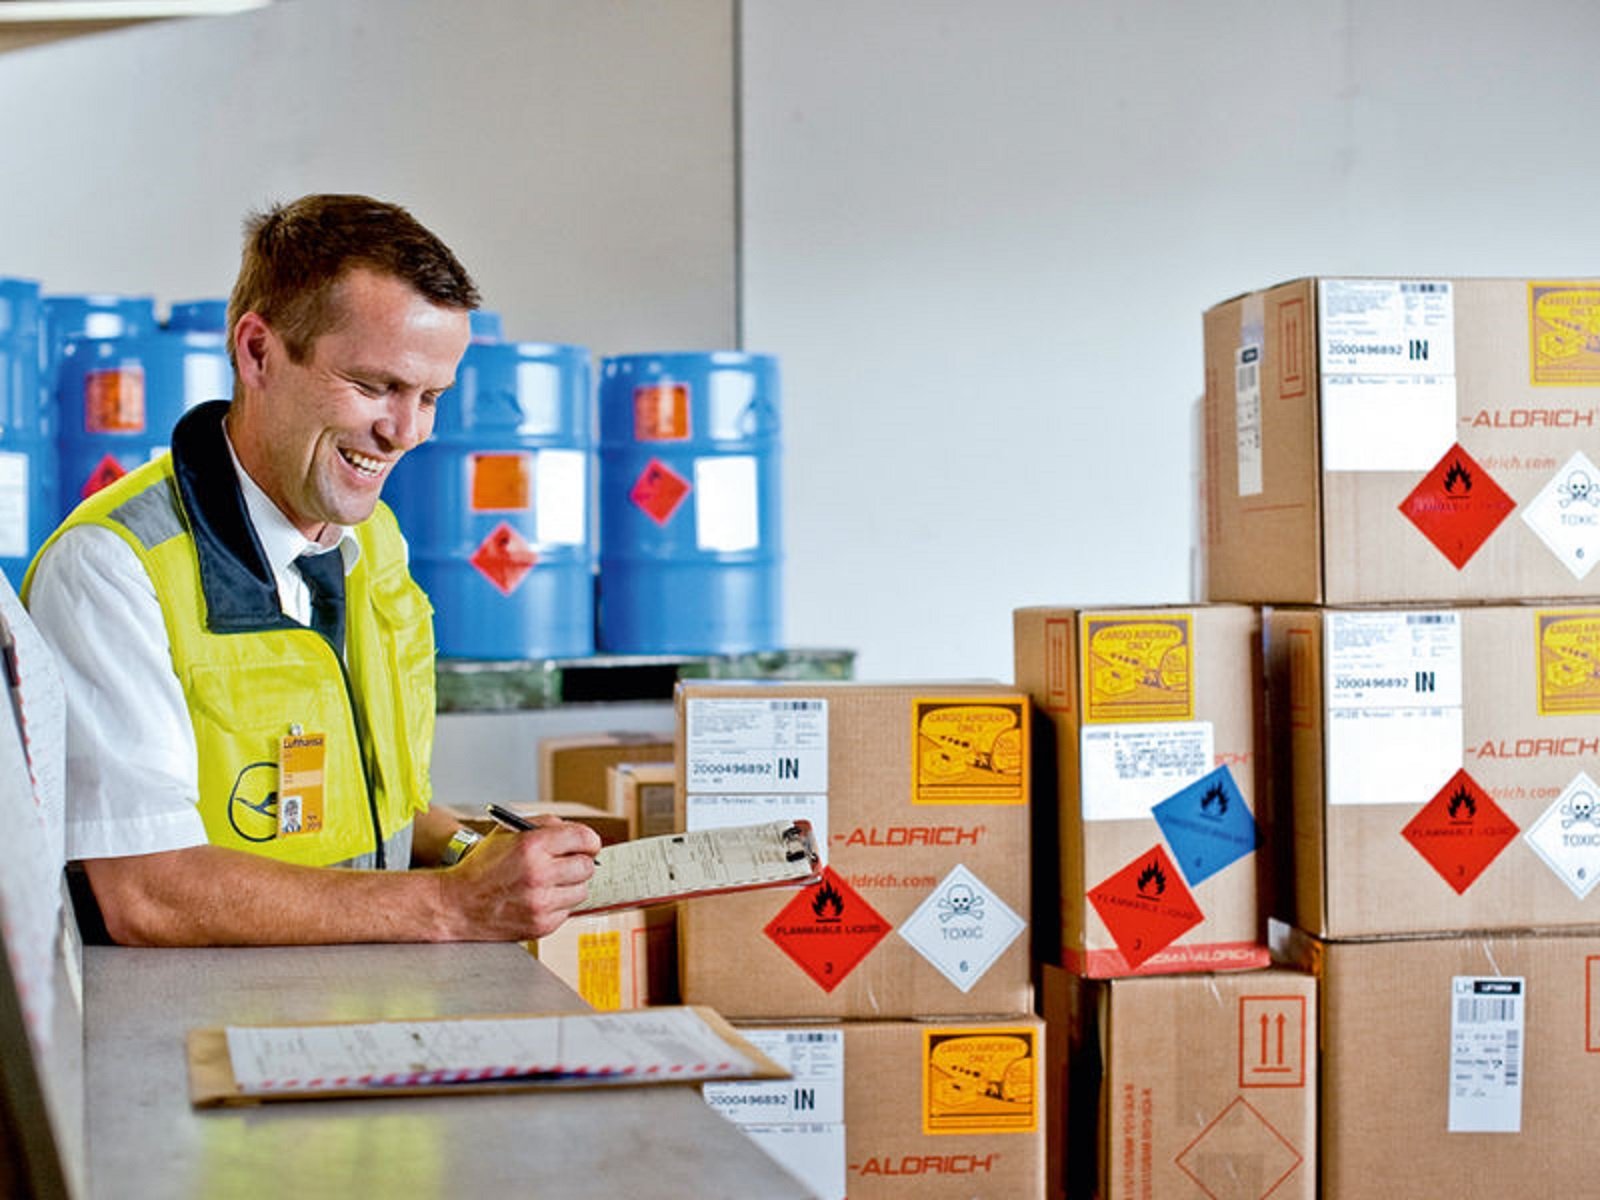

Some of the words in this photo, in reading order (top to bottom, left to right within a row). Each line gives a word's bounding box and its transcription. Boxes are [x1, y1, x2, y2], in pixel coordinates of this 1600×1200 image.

[1328, 344, 1403, 355] 2000496892
[1409, 340, 1428, 360] IN
[1575, 548, 1585, 560] 6
[1335, 678, 1408, 688] 2000496892
[1415, 671, 1435, 692] IN
[693, 763, 772, 775] 2000496892
[778, 758, 799, 779] IN
[1576, 867, 1586, 880] 6
[941, 926, 984, 941] TOXIC
[958, 960, 969, 973] 6
[794, 1088, 815, 1111] IN
